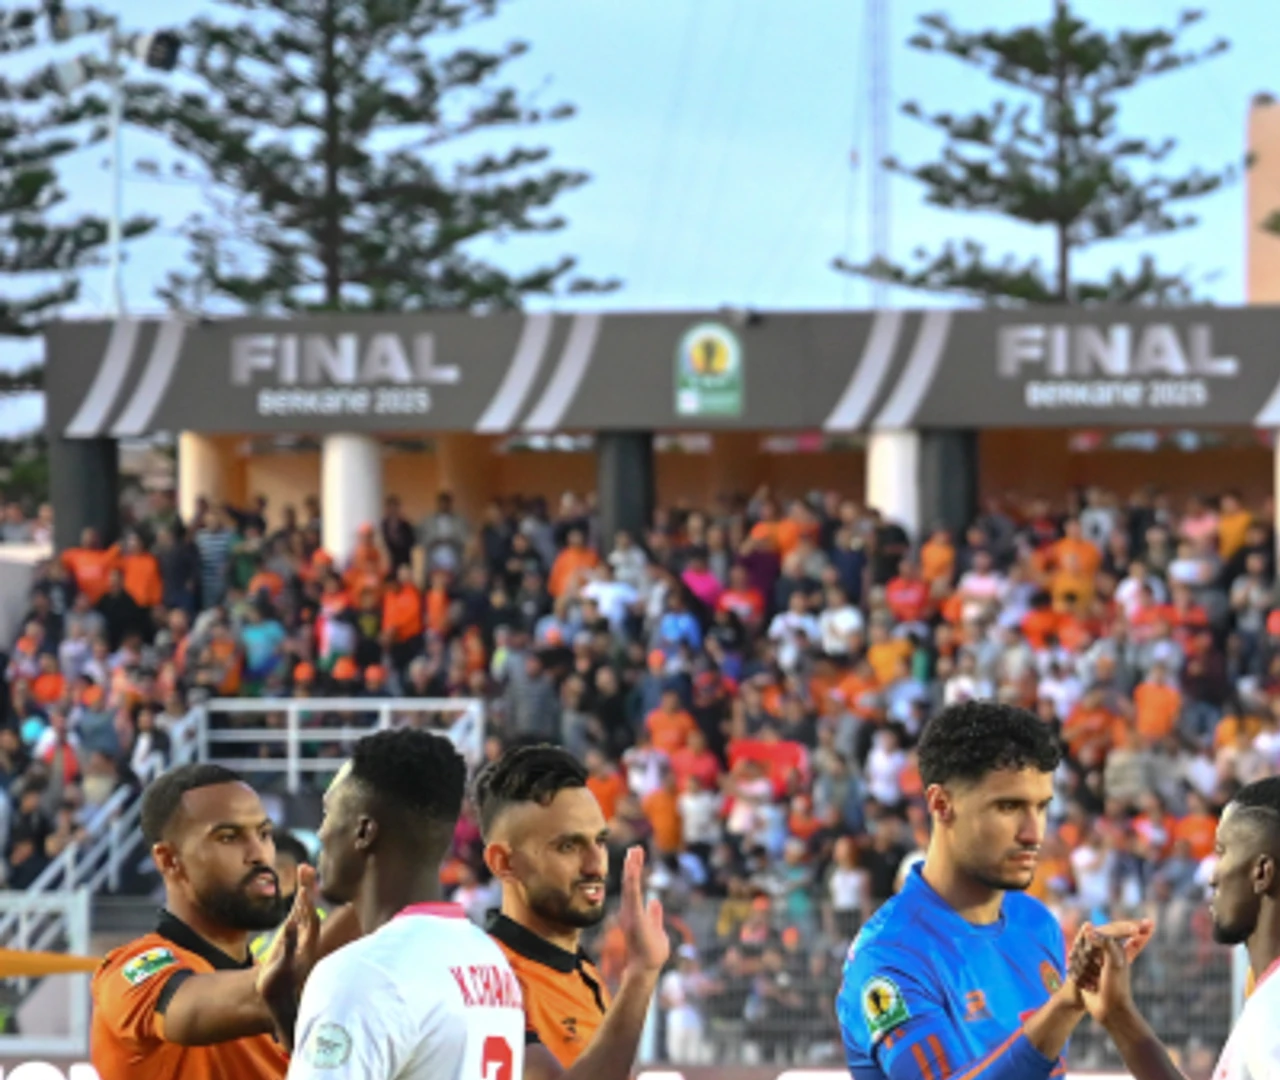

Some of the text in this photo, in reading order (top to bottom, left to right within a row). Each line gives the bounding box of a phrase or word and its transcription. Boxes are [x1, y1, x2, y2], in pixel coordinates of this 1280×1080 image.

[231, 332, 460, 385] FINAL
[998, 323, 1239, 377] FINAL
[375, 386, 431, 415] 2025
[1149, 378, 1208, 407] 2025
